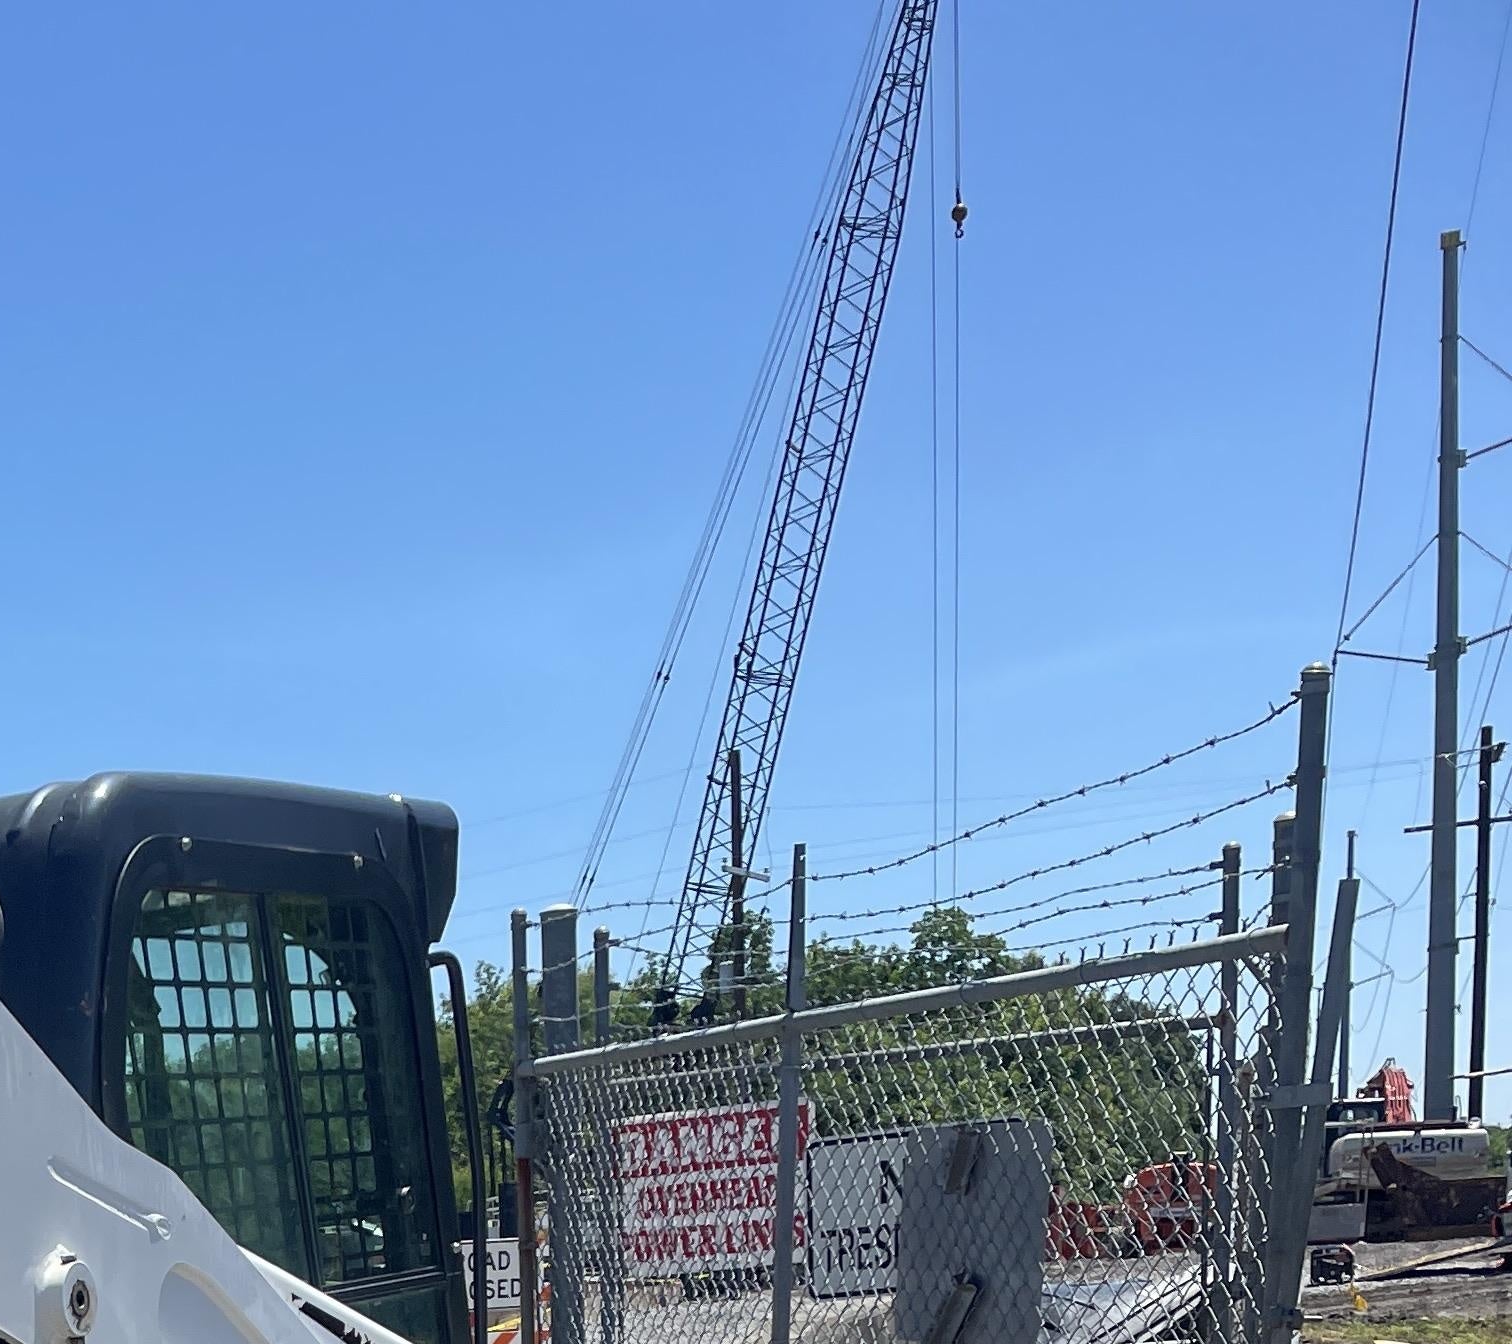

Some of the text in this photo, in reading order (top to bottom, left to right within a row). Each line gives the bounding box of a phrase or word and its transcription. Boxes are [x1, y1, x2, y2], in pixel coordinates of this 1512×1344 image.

[619, 1112, 800, 1174] DANGE
[726, 1212, 805, 1254] LINS
[820, 1222, 902, 1274] TRES
